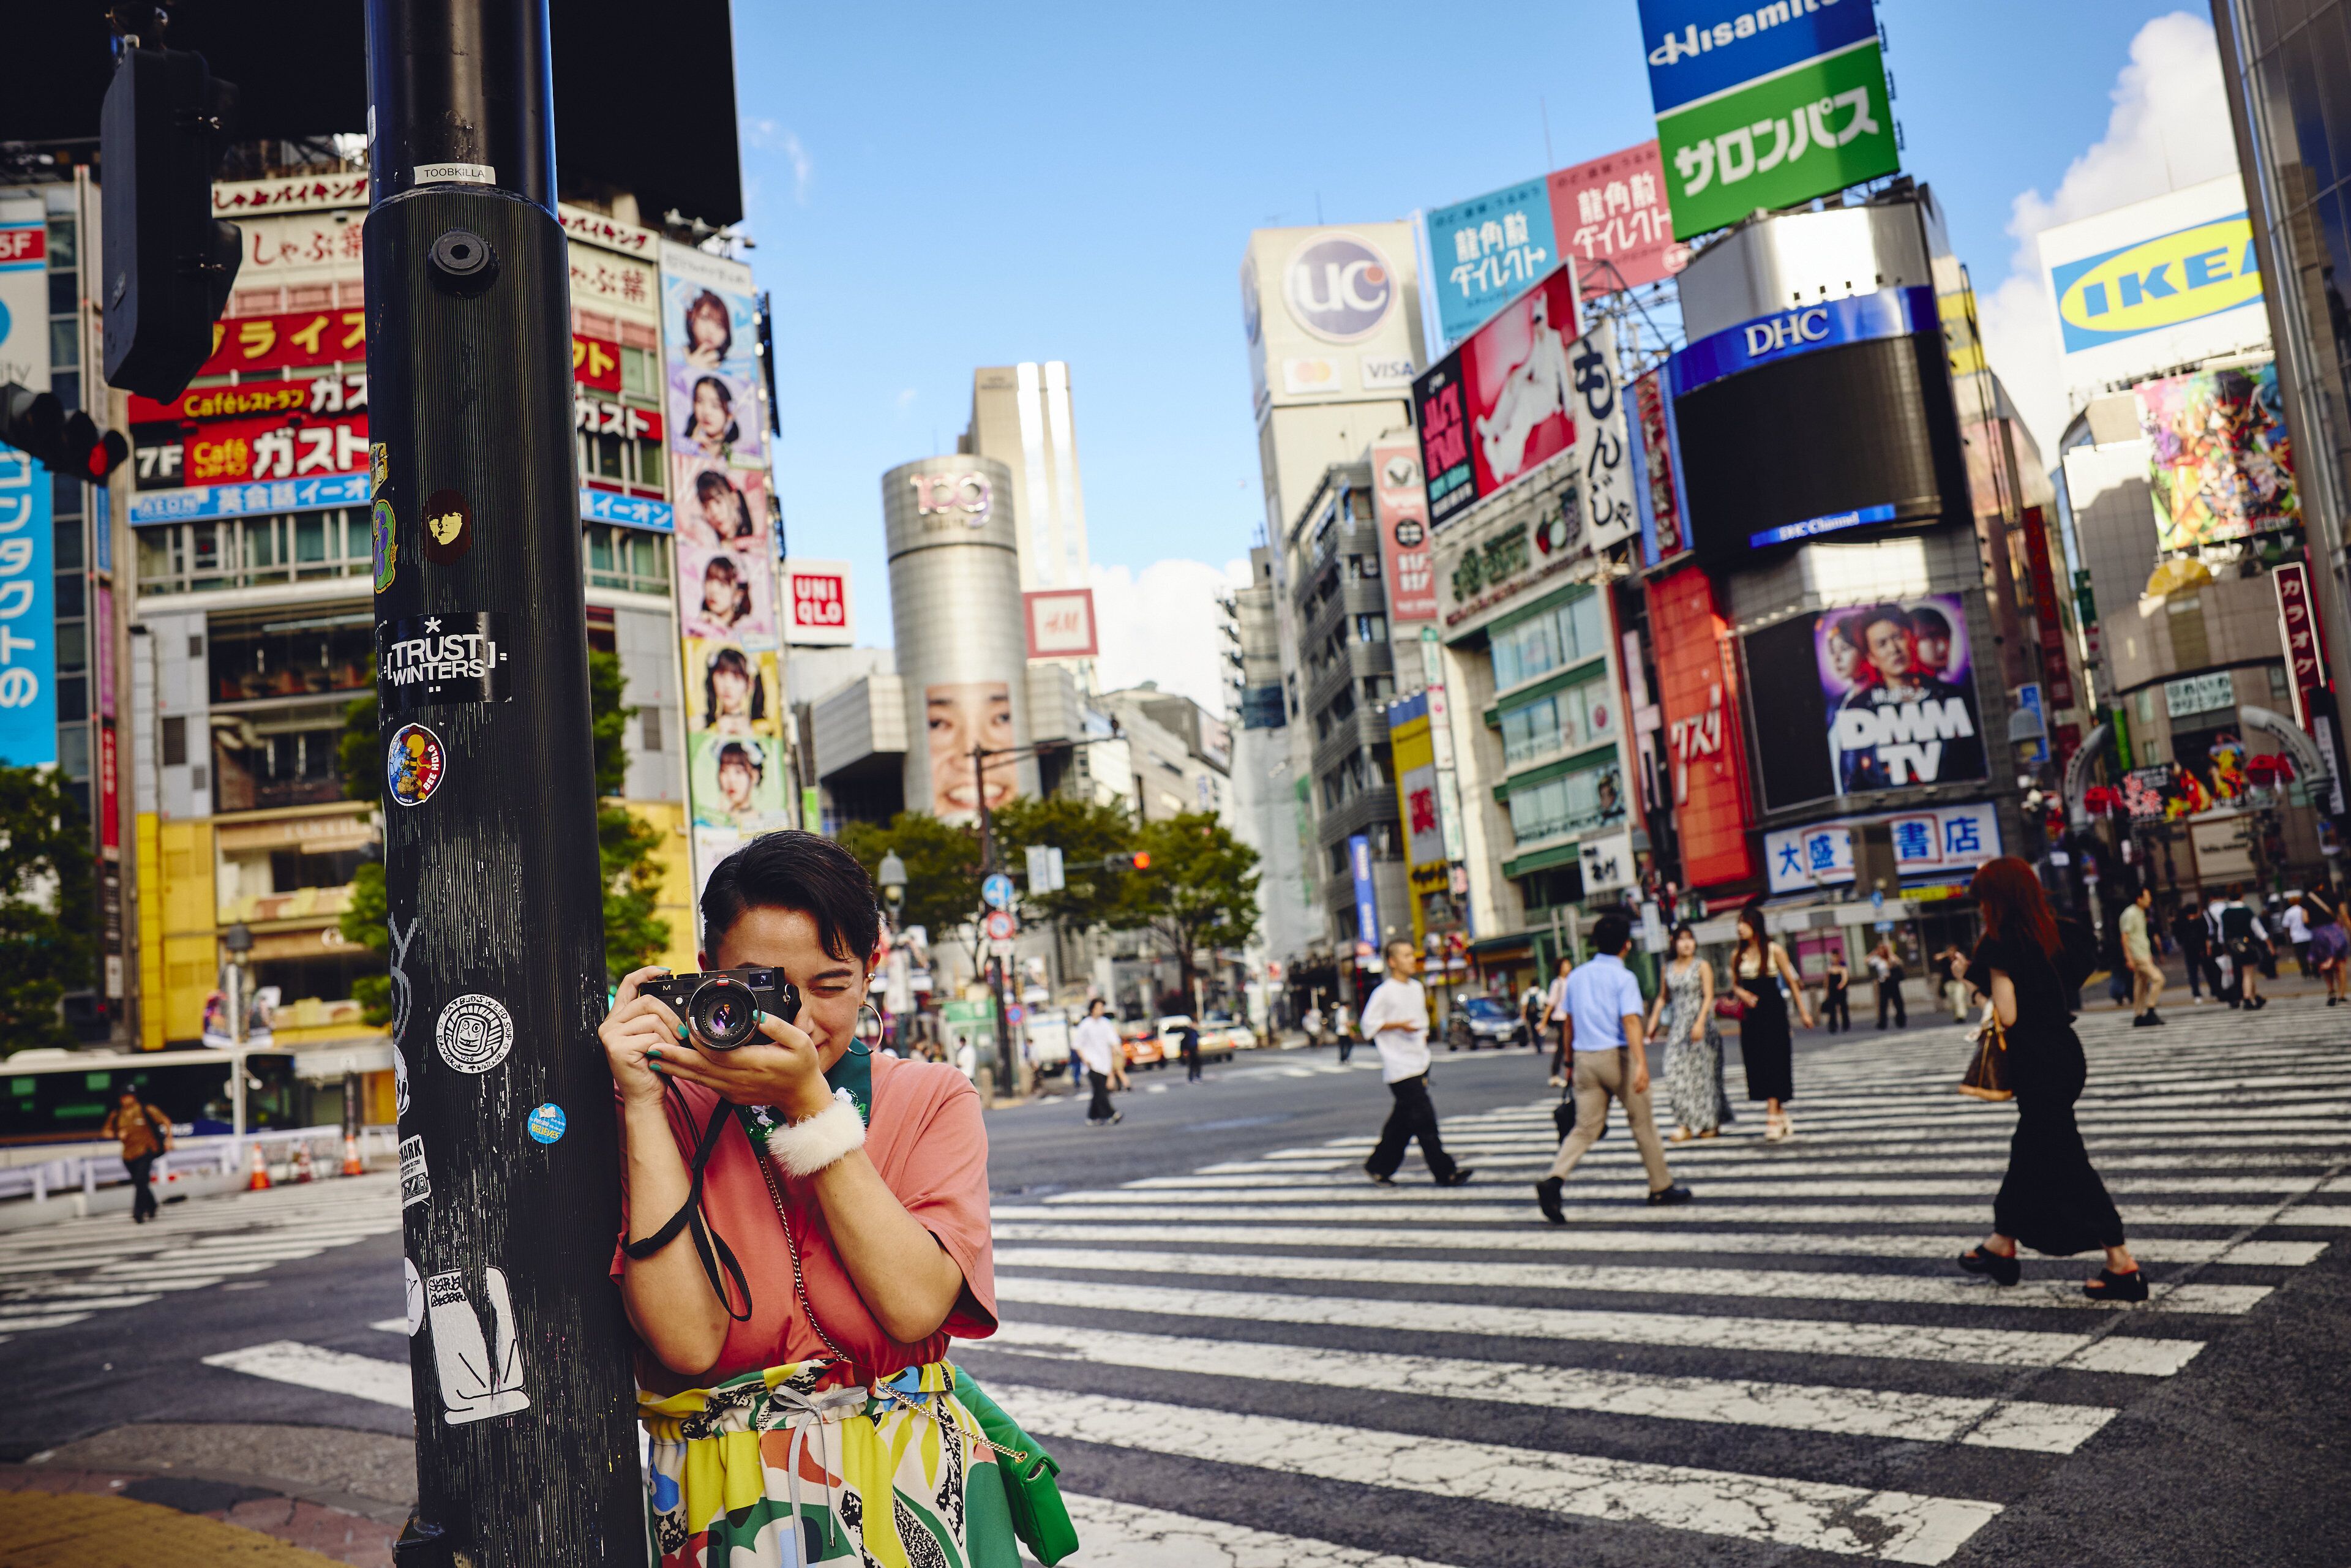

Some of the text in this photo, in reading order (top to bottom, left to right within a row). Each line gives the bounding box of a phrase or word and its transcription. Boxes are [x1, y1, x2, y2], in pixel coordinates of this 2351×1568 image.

[1649, 0, 1840, 66] Hisamit
[1674, 86, 1880, 197] サロンパス
[424, 168, 485, 178] TOOBKILLA
[1573, 206, 1672, 260] ダイレクト
[1450, 245, 1547, 298] ダイレクト
[1745, 309, 1829, 357] DHC
[1368, 362, 1415, 380] VISA
[193, 437, 248, 463] Café
[1573, 339, 1632, 530] もんじゃ
[136, 447, 184, 478] 7F
[253, 425, 369, 479] ガスト
[138, 495, 197, 516] AEON
[910, 471, 994, 529] 109
[1779, 521, 1808, 541] DHC
[796, 579, 838, 601] UNI
[797, 601, 842, 626] QLO
[391, 634, 484, 667] TRUST
[392, 659, 486, 686] WINTERS
[1836, 697, 1974, 751] DMM
[1876, 740, 1943, 786] TV
[422, 773, 437, 791] BEE
[1778, 817, 1980, 876] 大盛書店
[486, 999, 508, 1019] WEED
[437, 1035, 463, 1071] BANGKOK
[531, 1123, 561, 1139] BELIEVES
